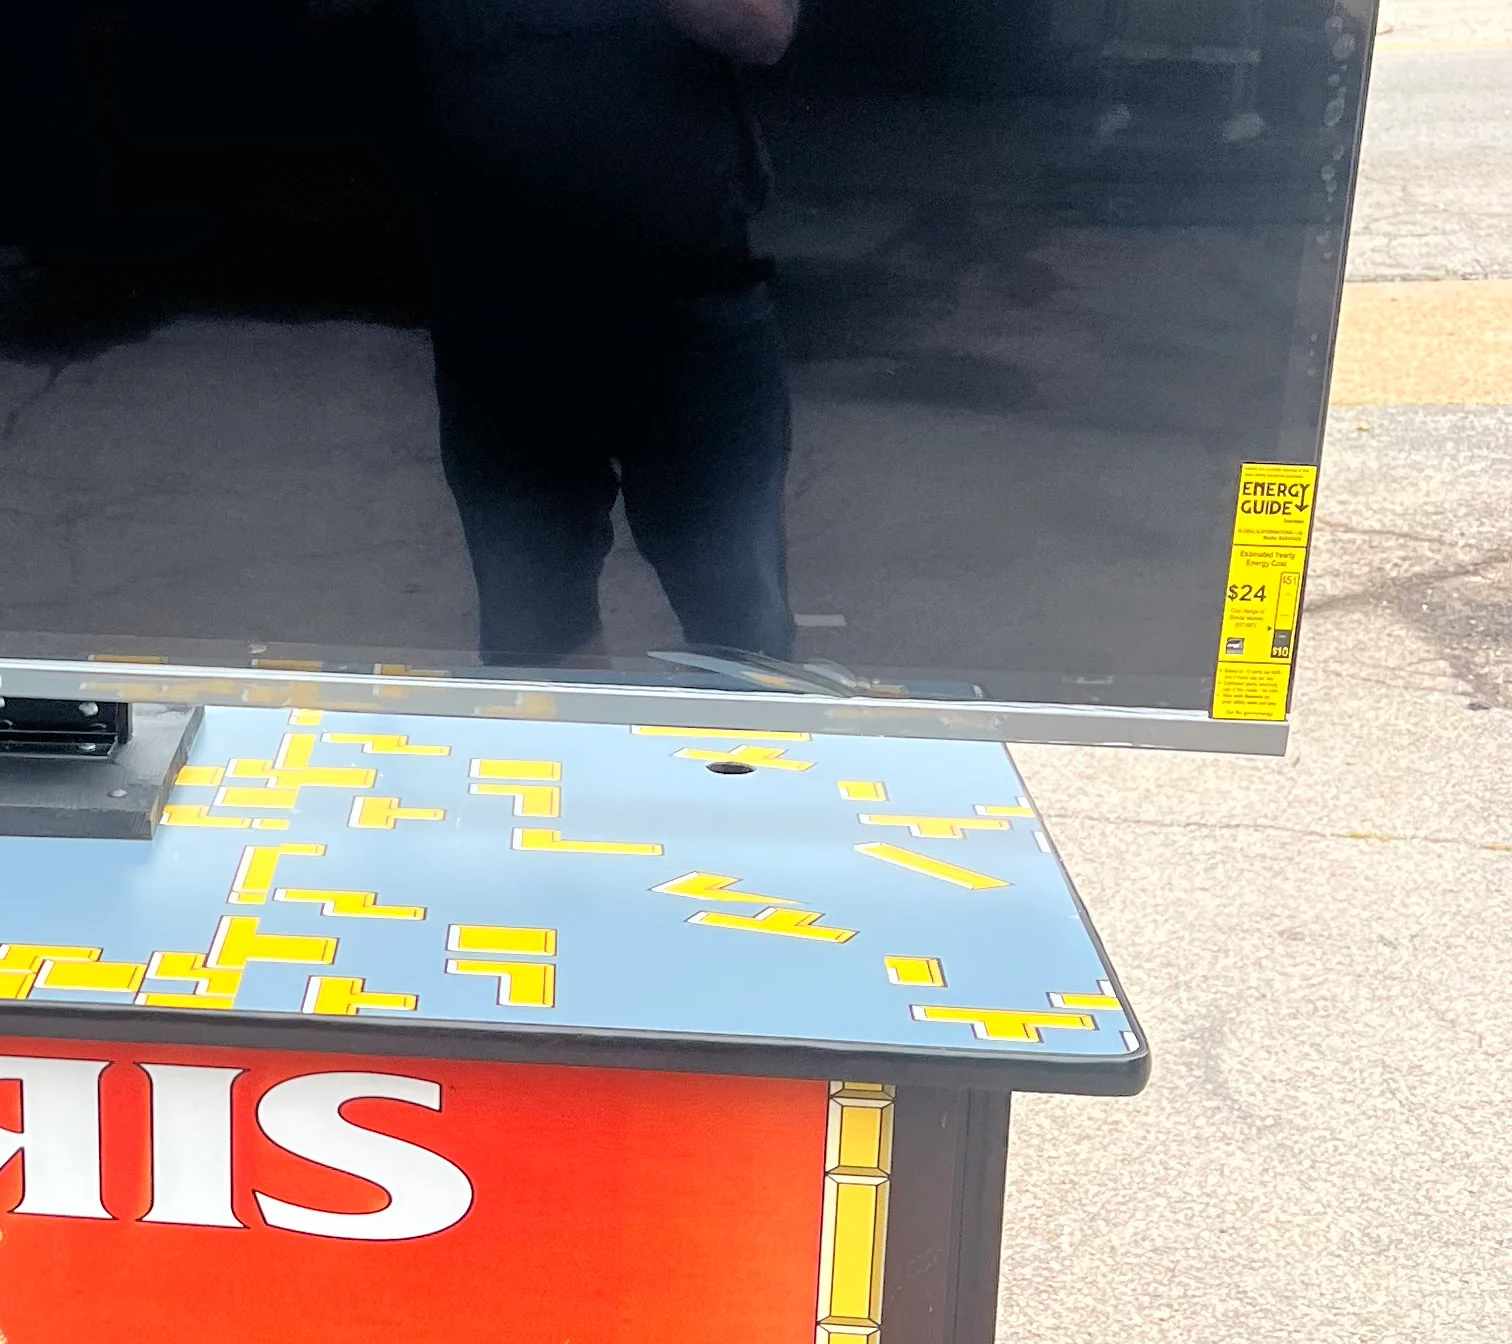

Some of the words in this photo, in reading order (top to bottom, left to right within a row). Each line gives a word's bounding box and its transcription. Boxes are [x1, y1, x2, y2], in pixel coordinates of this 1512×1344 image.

[1242, 481, 1311, 500] ENERGY
[1240, 500, 1293, 516] GUIDE
[1227, 584, 1267, 602] $24
[1272, 646, 1289, 657] $10
